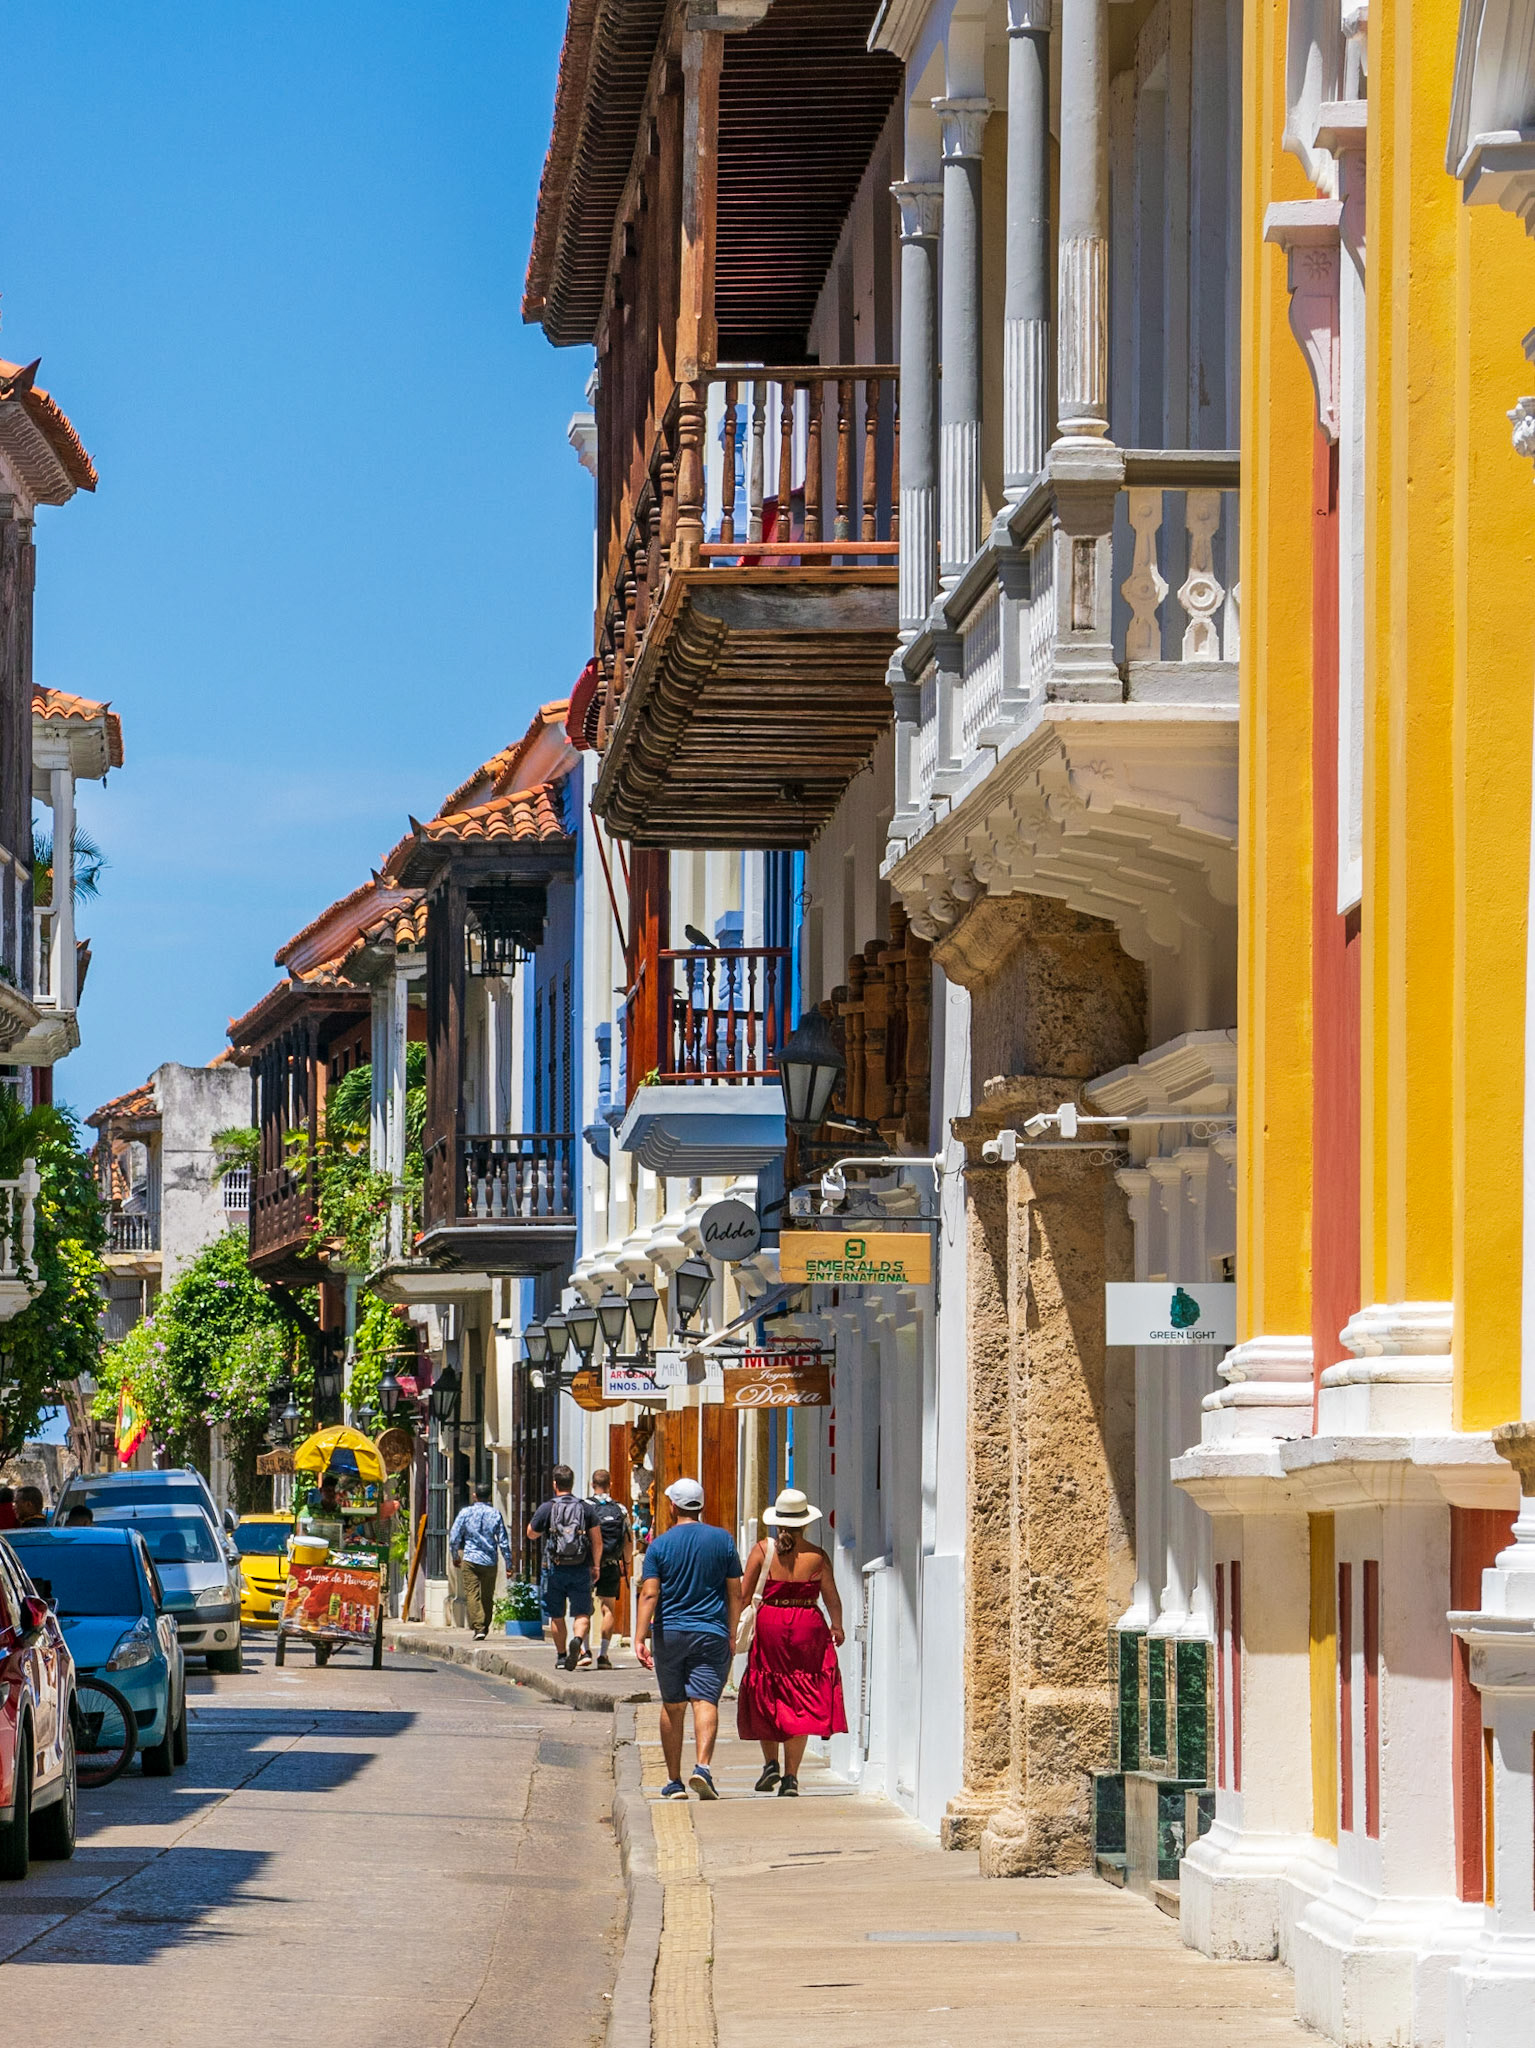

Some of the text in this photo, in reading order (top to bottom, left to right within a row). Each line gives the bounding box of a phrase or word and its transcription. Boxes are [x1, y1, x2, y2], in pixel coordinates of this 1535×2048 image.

[806, 1260, 904, 1272] EMERALDS
[806, 1272, 909, 1283] INTERNATIONAL
[1149, 1330, 1216, 1339] GREEN LIGHT
[609, 1382, 640, 1391] HNOS.
[732, 1383, 822, 1407] Doria
[304, 1569, 329, 1585] Jugos
[330, 1572, 342, 1583] de
